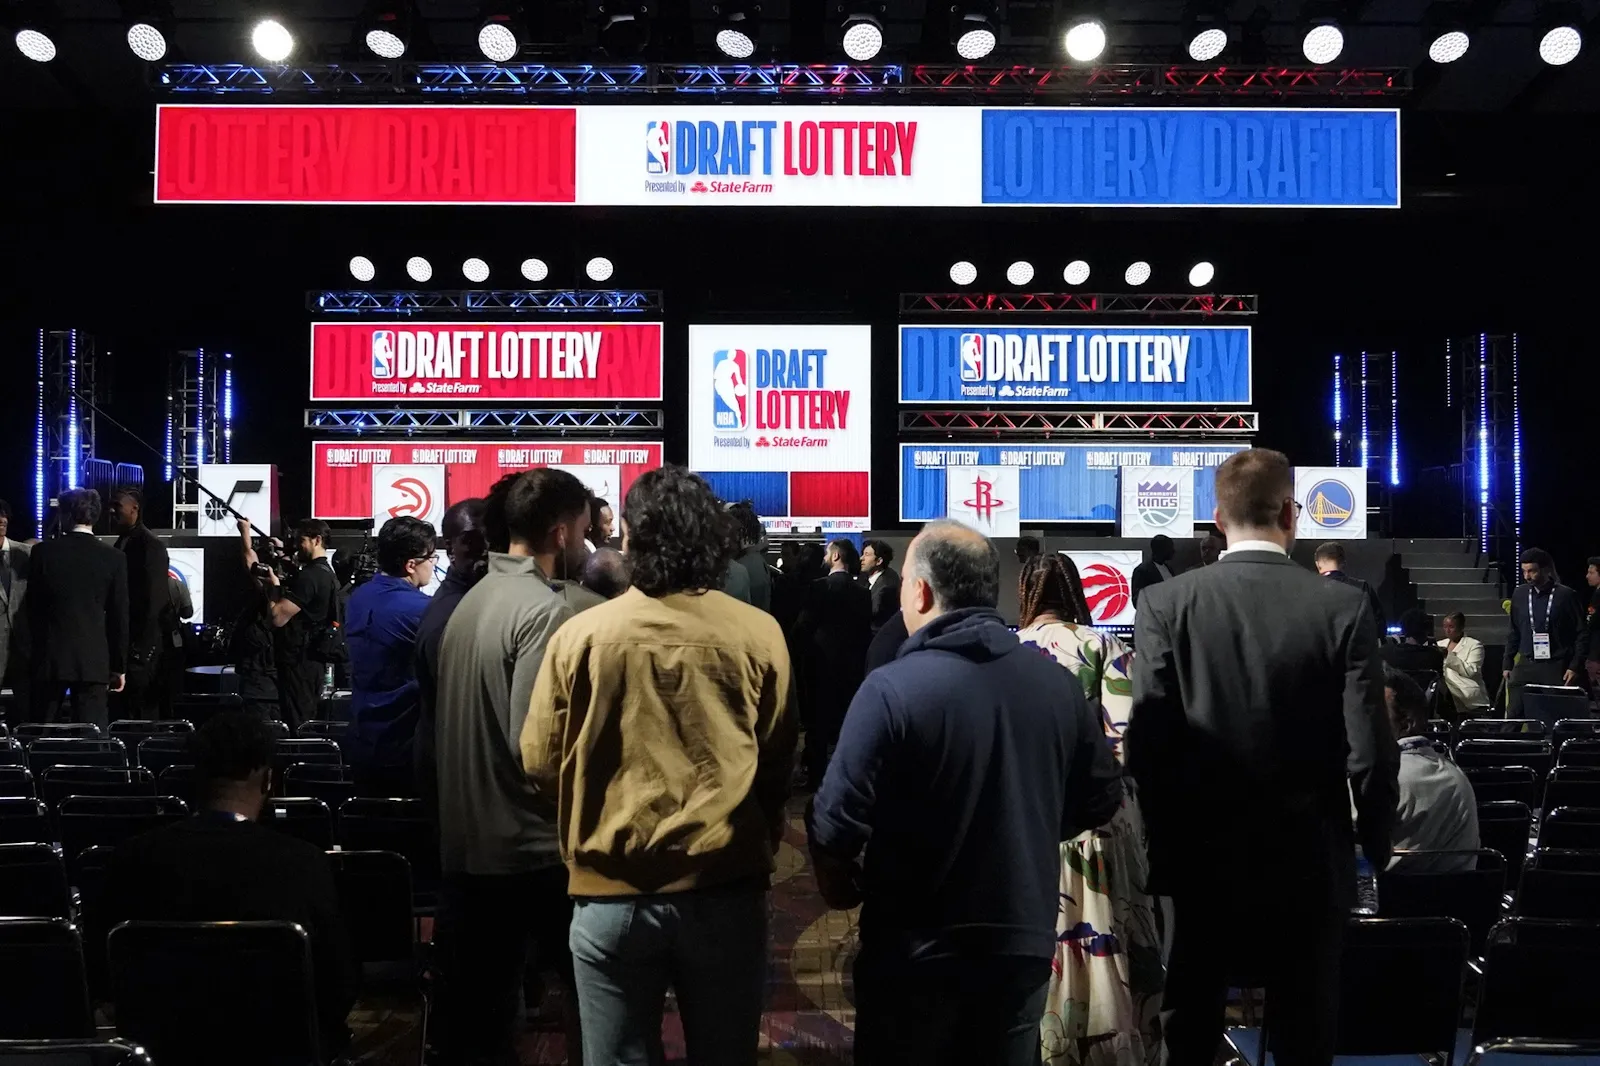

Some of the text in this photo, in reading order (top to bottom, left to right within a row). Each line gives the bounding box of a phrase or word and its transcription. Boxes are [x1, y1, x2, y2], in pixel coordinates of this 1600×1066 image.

[160, 113, 352, 195] LOTTERY
[378, 113, 525, 195] DRAFT
[676, 121, 917, 176] DRAFT LOTTERY
[984, 115, 1178, 197] LOTTERY
[1204, 117, 1349, 198] DRAFT
[645, 180, 686, 195] Presented by
[398, 331, 483, 378] DRAFT
[488, 332, 602, 379] LOTTERY
[986, 334, 1072, 381] DRAFT
[1077, 335, 1190, 382] LOTTERY
[756, 349, 827, 388] DRAFT
[372, 382, 407, 394] Presented by
[961, 385, 996, 397] Presented by
[756, 390, 851, 429] LOTTERY
[716, 412, 735, 425] NBA
[714, 435, 750, 449] Presented by
[334, 449, 391, 463] DRAFT LOTTERY
[420, 449, 477, 463] DRAFT LOTTERY
[506, 450, 563, 463] DRAFT LOTTERY
[591, 450, 649, 463] DRAFT LOTTERY
[921, 451, 979, 465] DRAFT LOTTERY
[1008, 451, 1066, 466] DRAFT LOTTERY
[1093, 452, 1152, 466] DRAFT LOTTERY
[1180, 452, 1204, 466] DRAFT
[1138, 498, 1178, 507] KINGS
